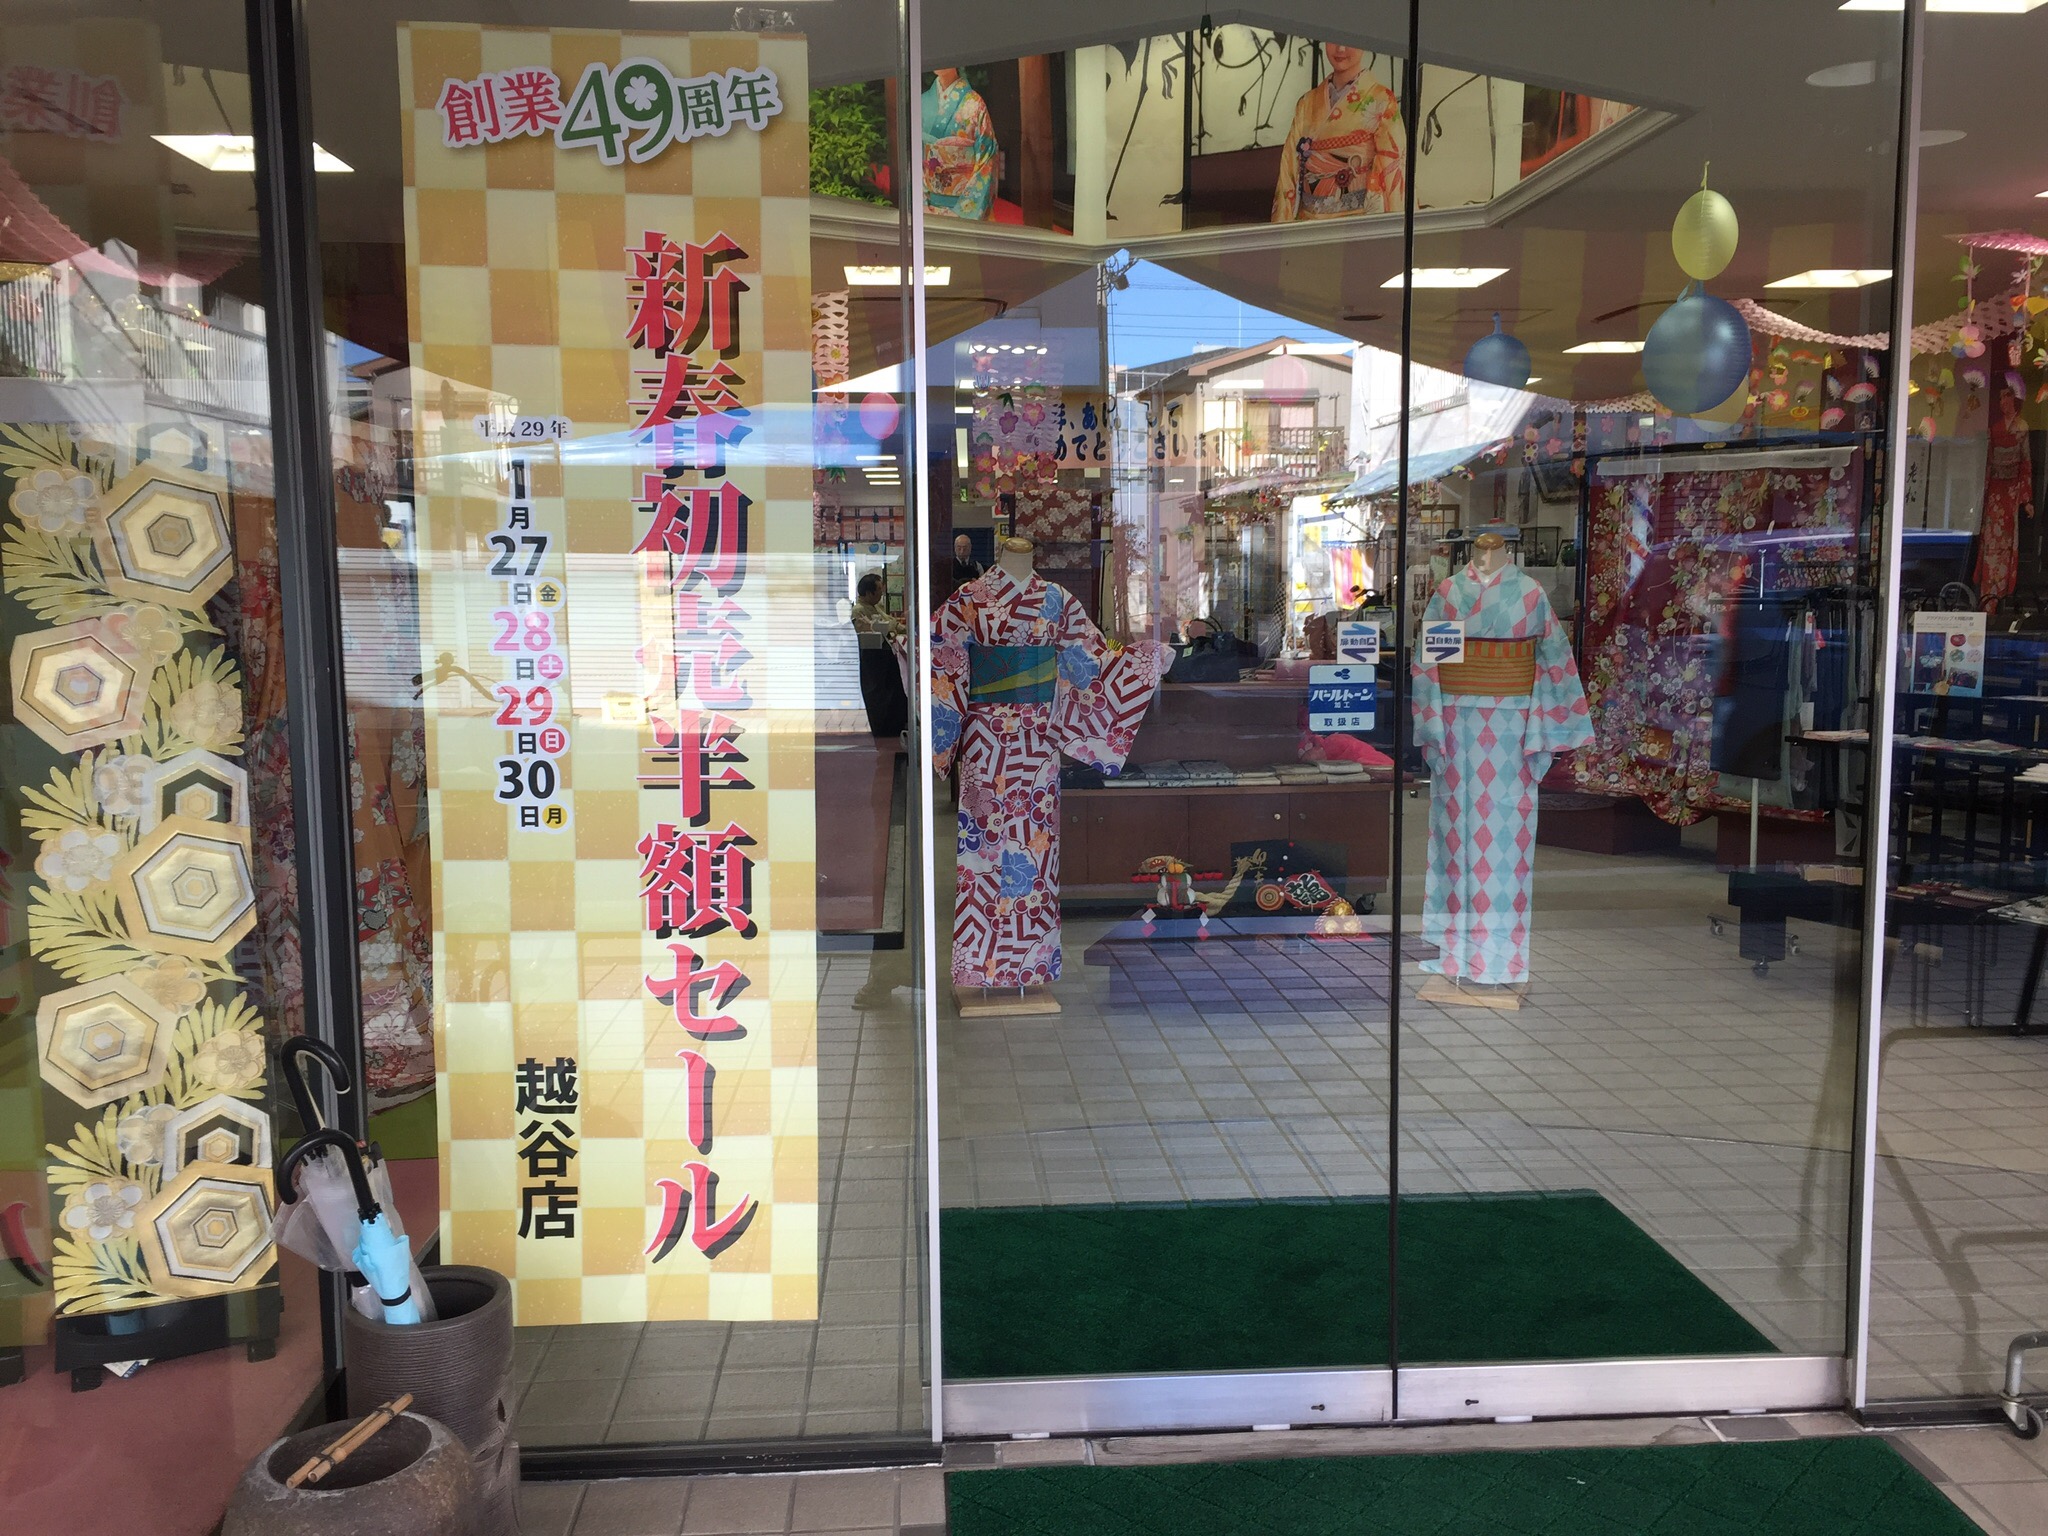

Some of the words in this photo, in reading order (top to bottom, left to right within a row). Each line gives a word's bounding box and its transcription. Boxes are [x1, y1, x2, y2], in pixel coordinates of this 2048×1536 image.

[441, 63, 776, 159] 創業49周年
[624, 230, 757, 1262] 新春初売半額セール
[516, 1057, 578, 1240] 越谷店
